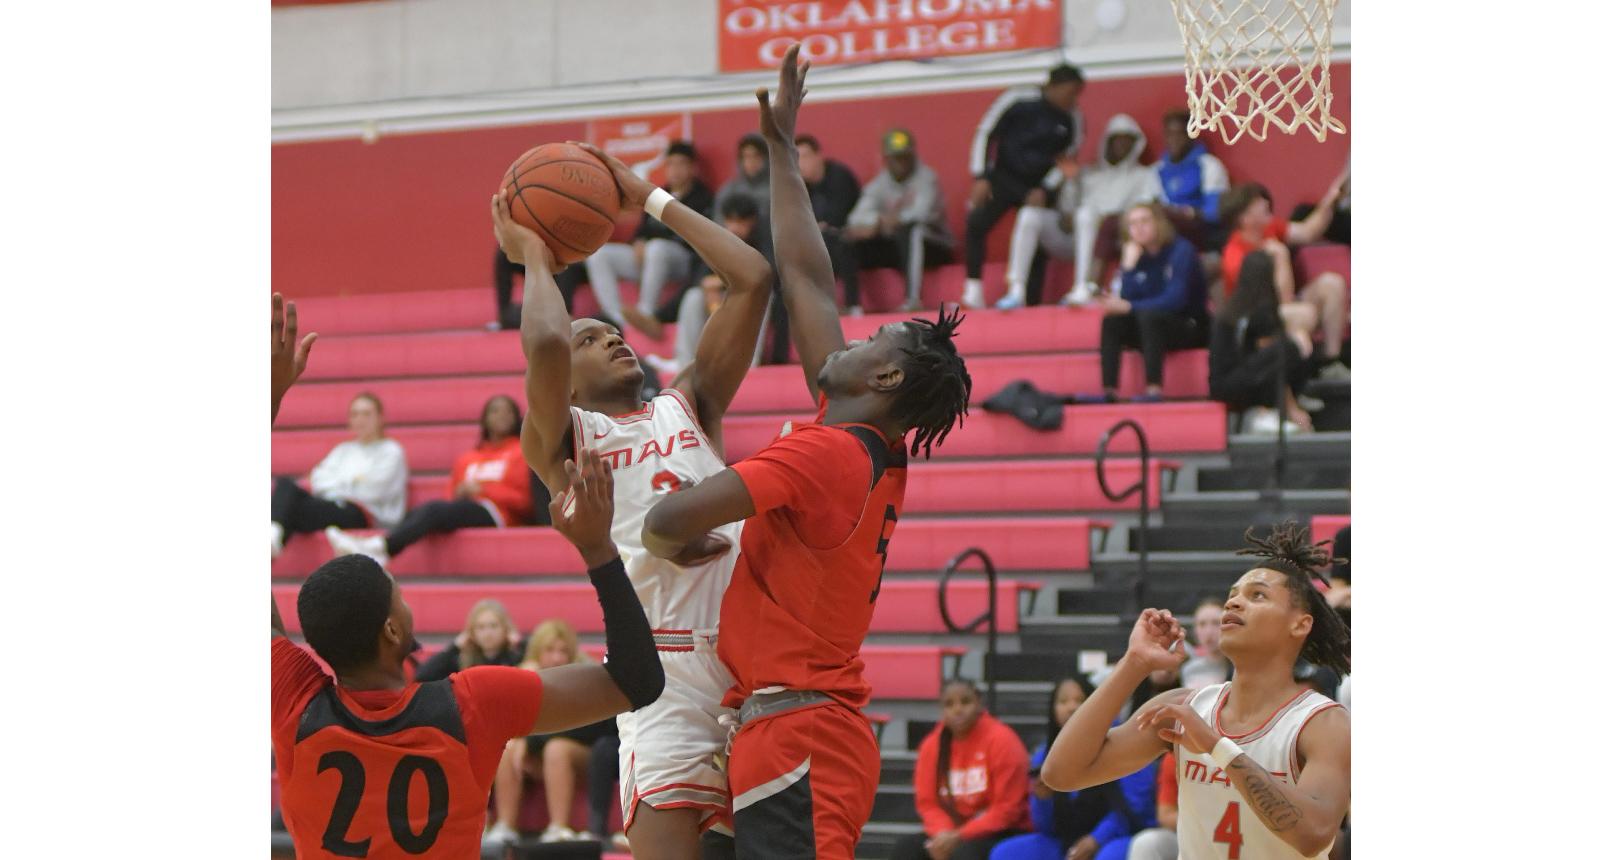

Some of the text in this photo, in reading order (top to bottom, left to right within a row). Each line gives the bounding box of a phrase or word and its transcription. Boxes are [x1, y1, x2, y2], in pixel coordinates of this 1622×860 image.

[758, 19, 1015, 67] COLLEGE
[600, 429, 701, 471] MAVS
[316, 750, 449, 858] 20
[1213, 801, 1243, 860] 4
